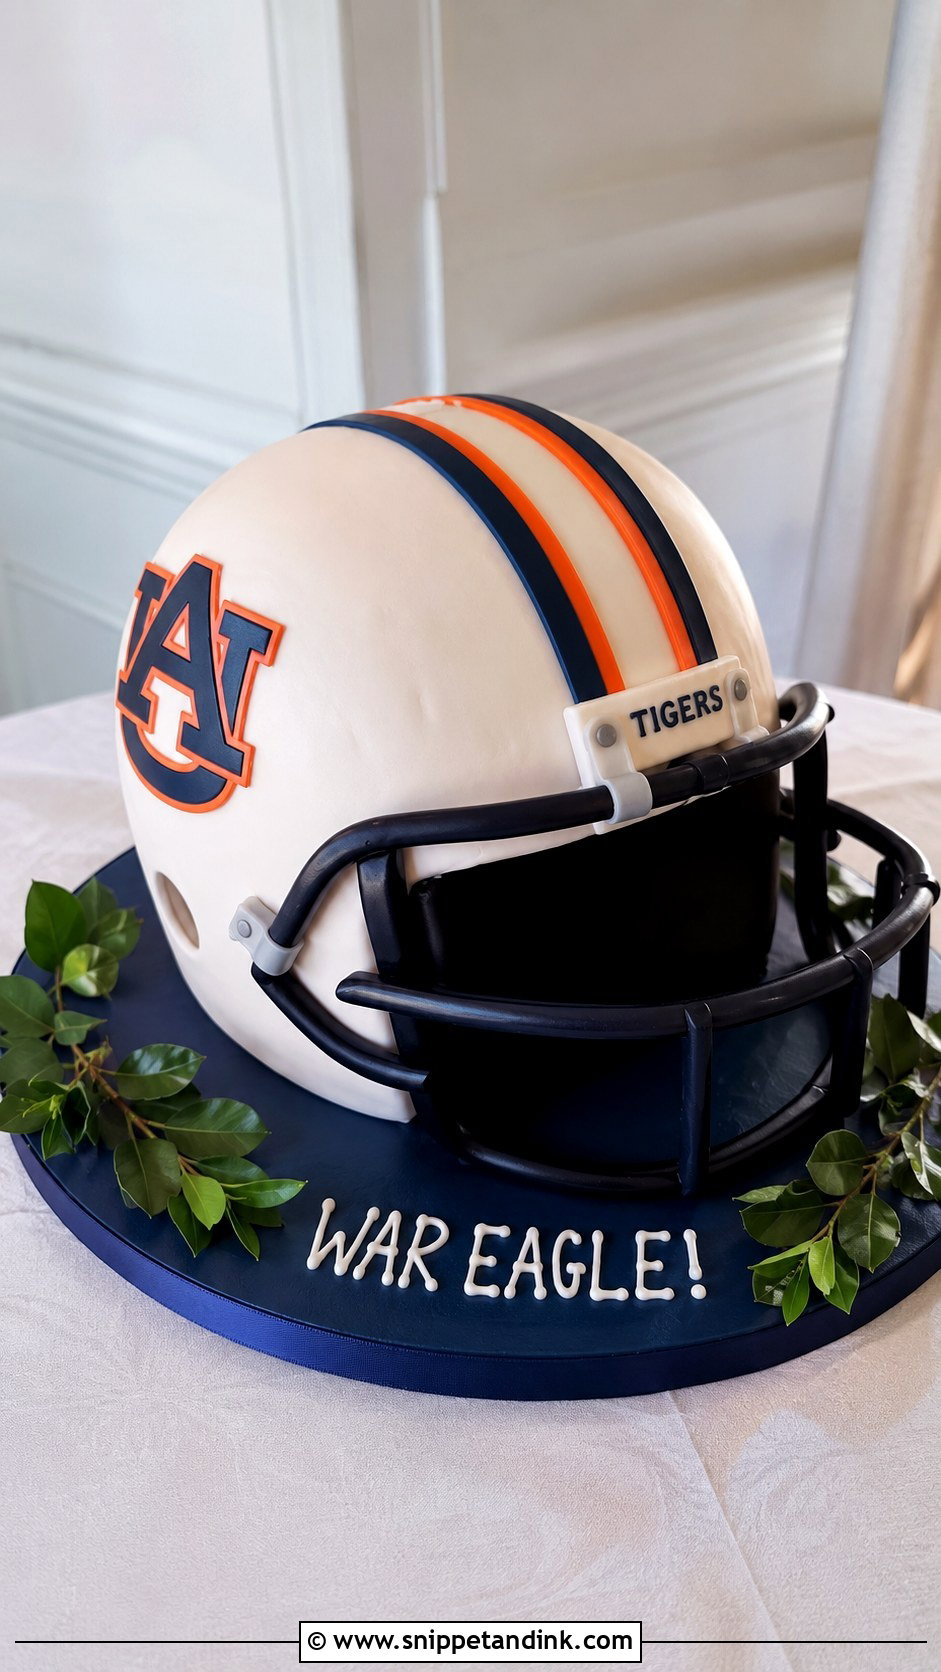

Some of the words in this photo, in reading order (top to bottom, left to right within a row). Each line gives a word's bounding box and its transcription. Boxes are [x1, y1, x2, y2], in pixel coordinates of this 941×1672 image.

[629, 684, 724, 738] TIGERS
[306, 1197, 450, 1292] WAR
[463, 1222, 707, 1301] EAGLE!
